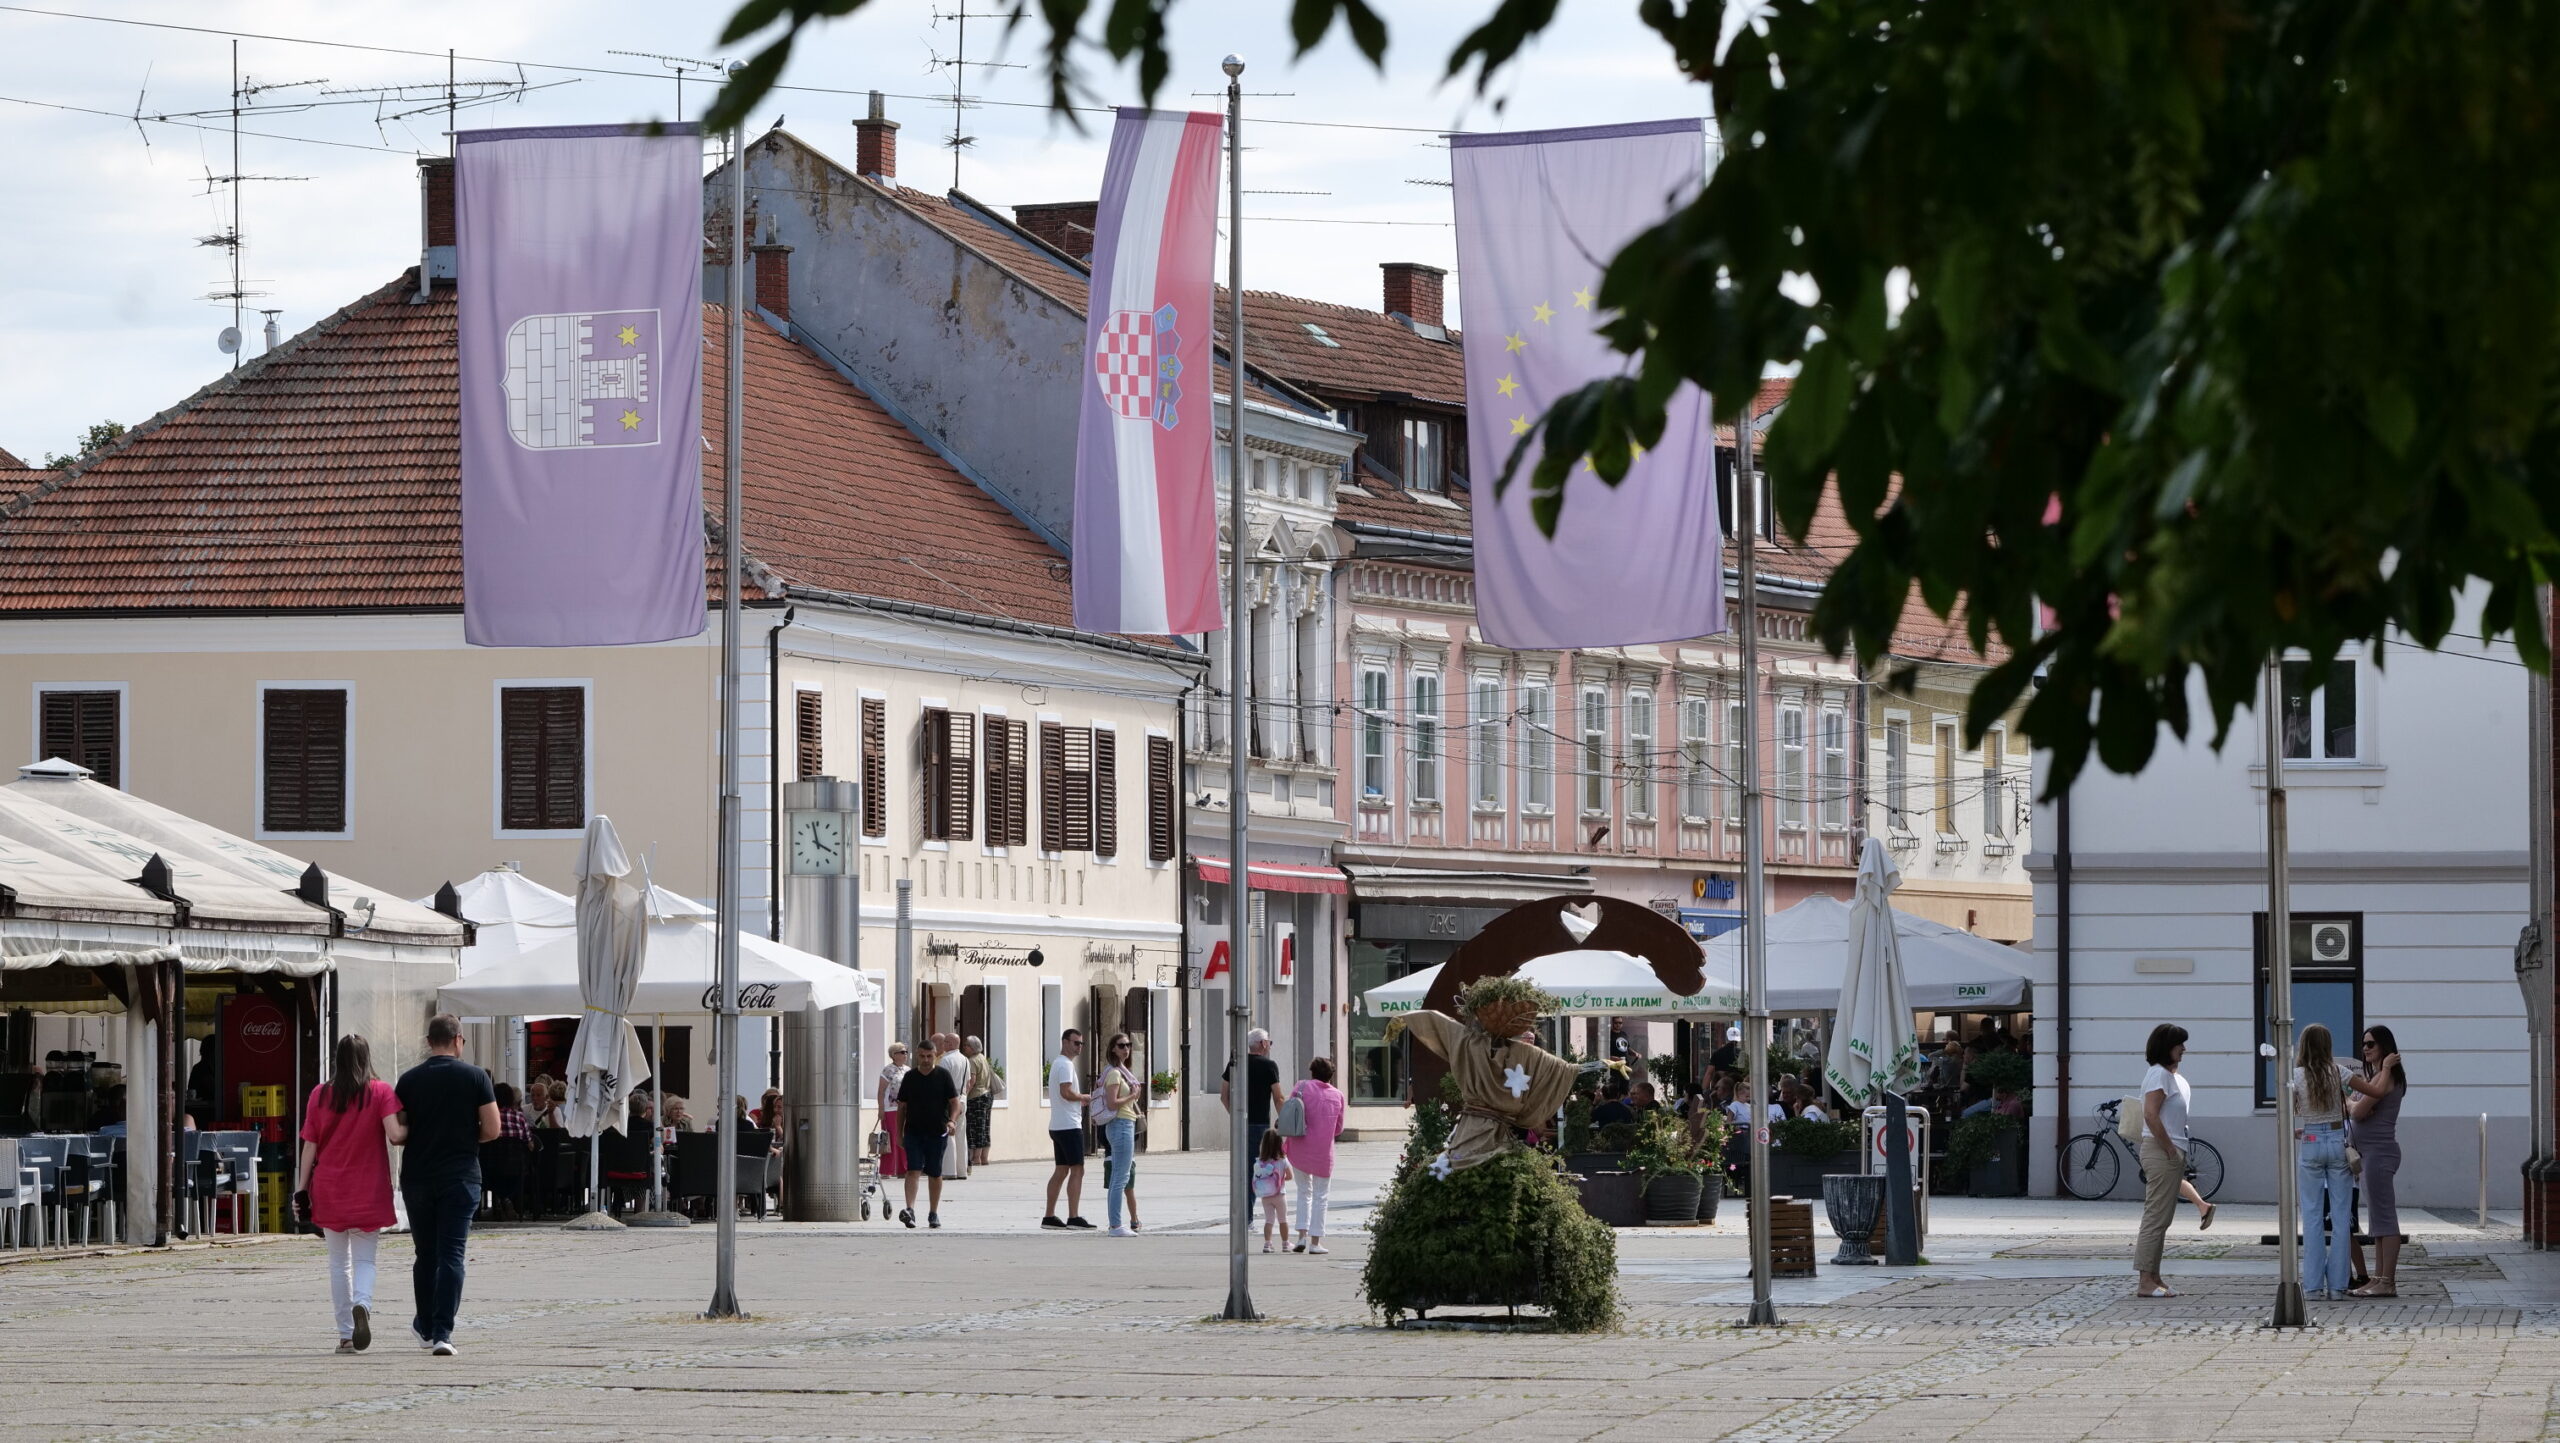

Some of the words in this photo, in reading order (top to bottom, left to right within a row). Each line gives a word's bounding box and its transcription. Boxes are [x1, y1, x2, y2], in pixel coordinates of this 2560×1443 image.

[964, 950, 1028, 970] Brijačnica
[1958, 986, 1986, 996] PAN
[1380, 1001, 1411, 1012] PAN
[1591, 997, 1602, 1007] TO
[1604, 997, 1614, 1007] TE
[1616, 997, 1629, 1007] JA
[1631, 997, 1662, 1008] PITAM!
